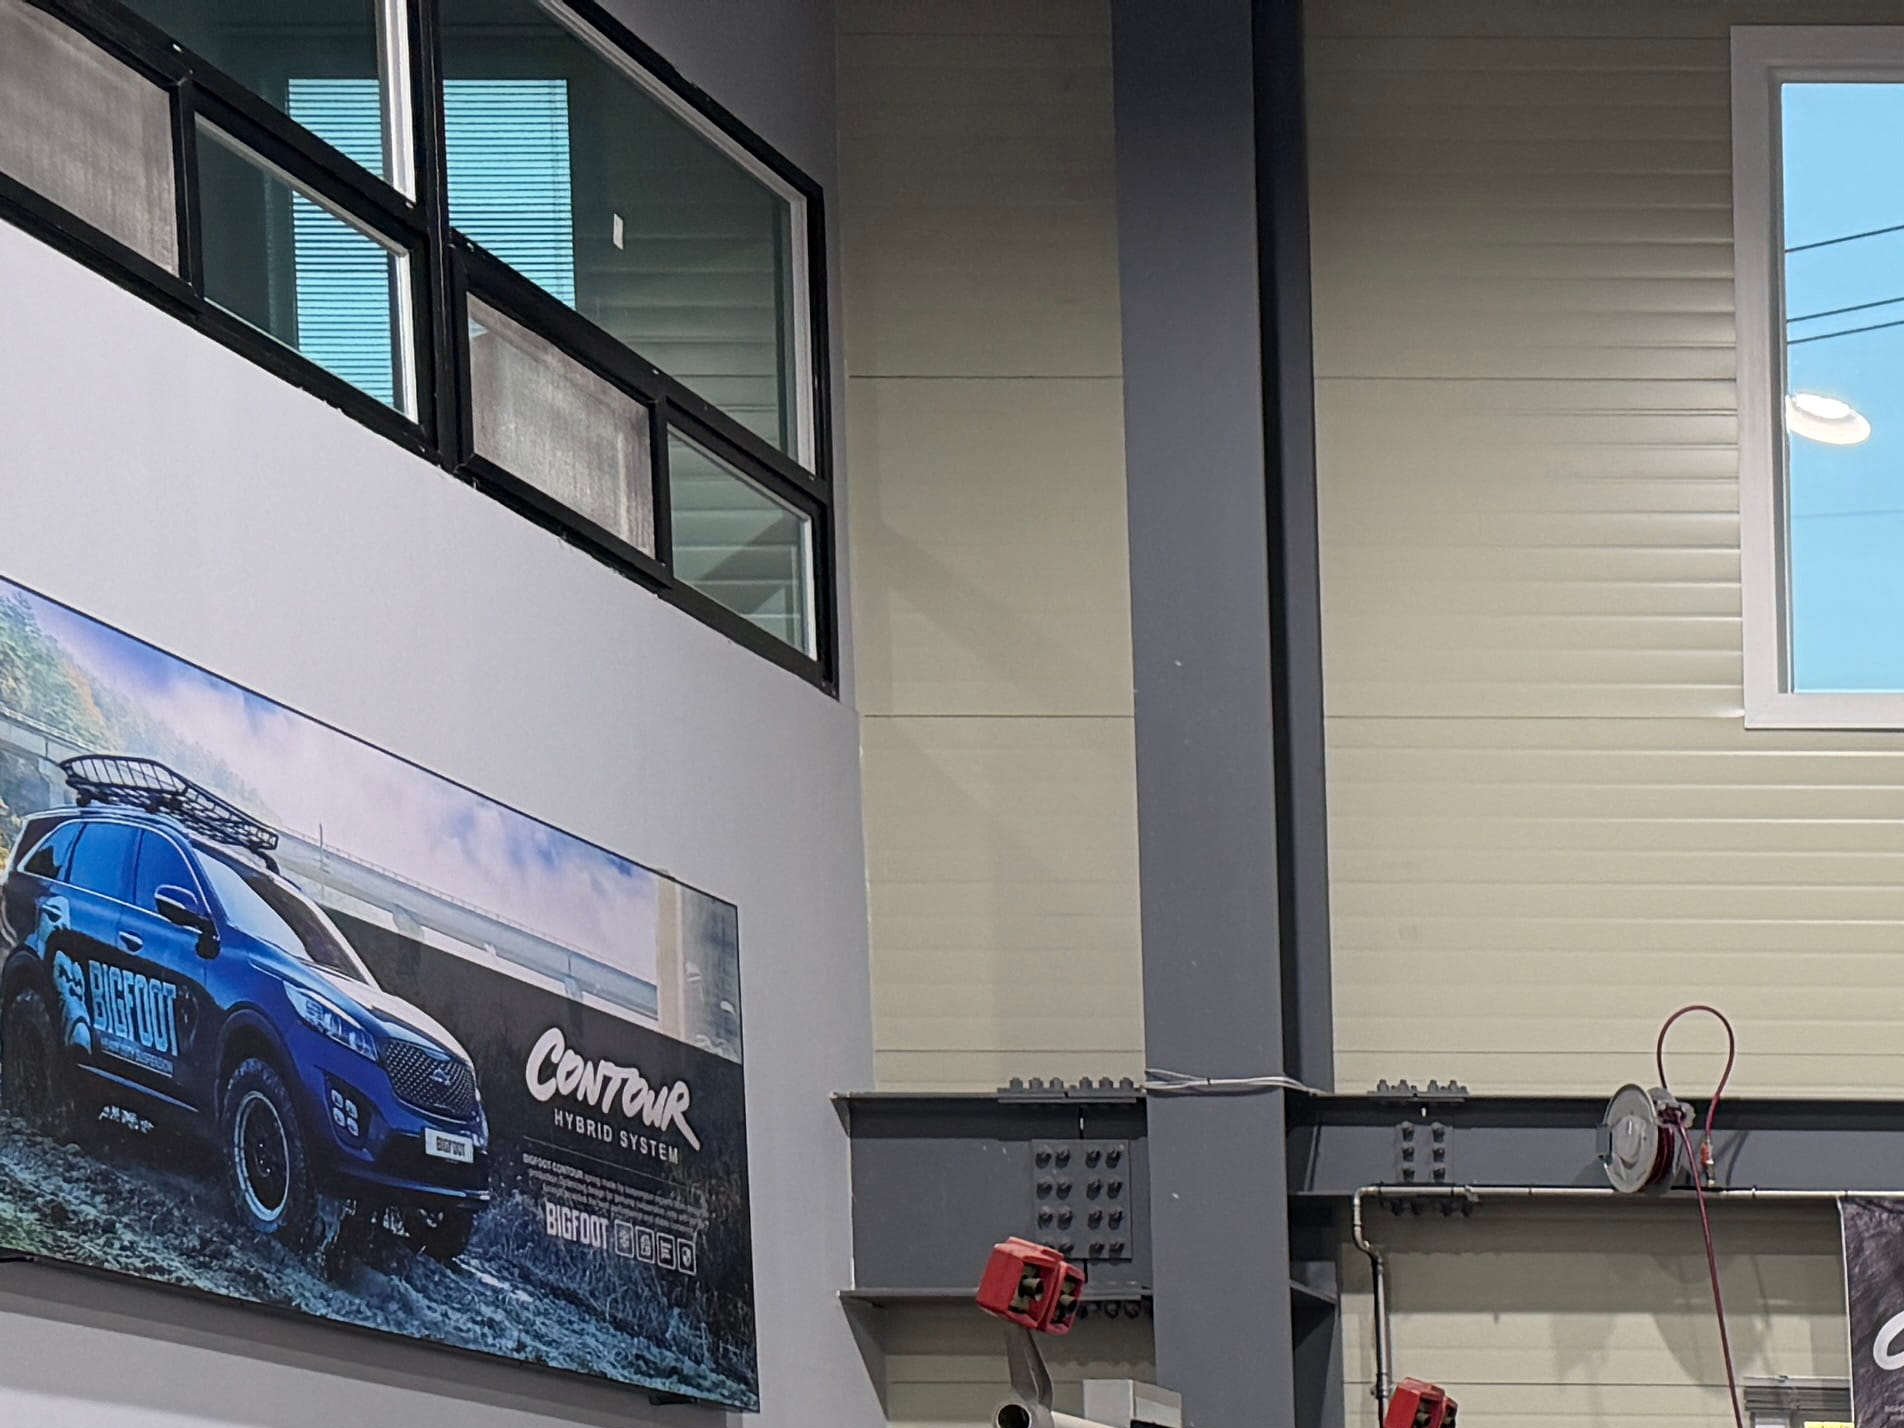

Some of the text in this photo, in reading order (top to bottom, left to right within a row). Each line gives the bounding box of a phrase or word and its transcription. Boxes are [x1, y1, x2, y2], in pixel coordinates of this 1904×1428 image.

[88, 959, 179, 1057] BIGFOOT
[525, 1027, 701, 1151] CONTOUR
[554, 1108, 680, 1165] HYBRID SYSTEM
[545, 1199, 610, 1250] BIGFOOT
